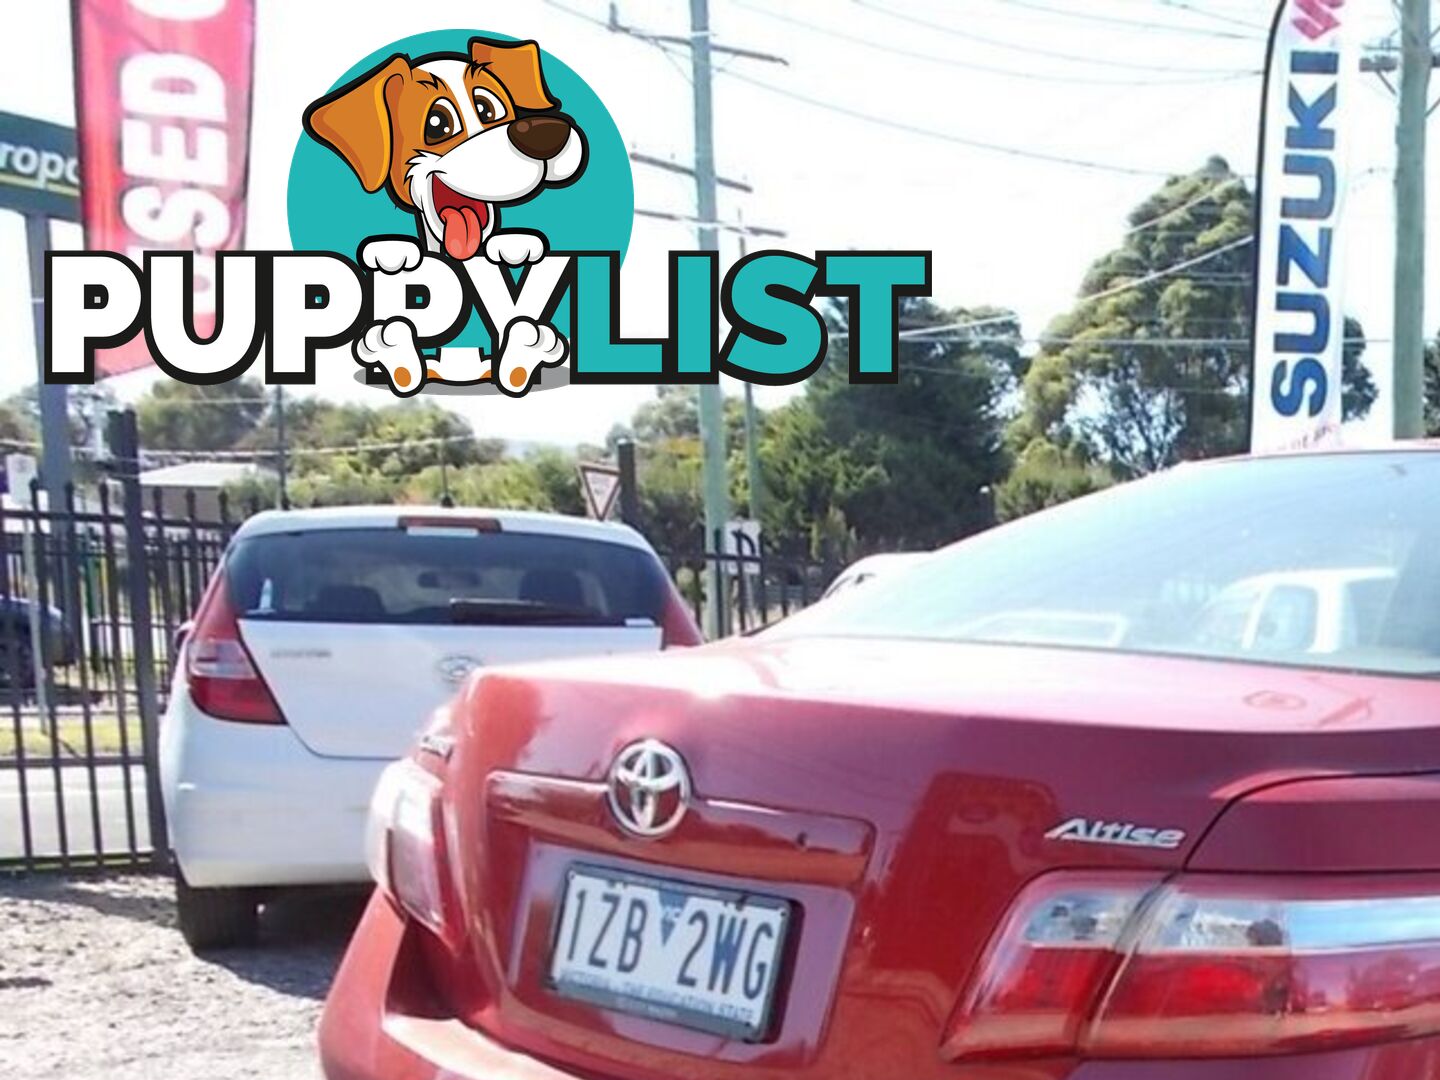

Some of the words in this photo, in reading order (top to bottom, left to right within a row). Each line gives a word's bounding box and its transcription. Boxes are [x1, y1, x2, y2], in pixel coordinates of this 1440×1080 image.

[1270, 50, 1340, 419] SUZUKI
[1043, 817, 1187, 849] Altise
[567, 888, 649, 974] 1ZB
[676, 908, 774, 1000] 2WG
